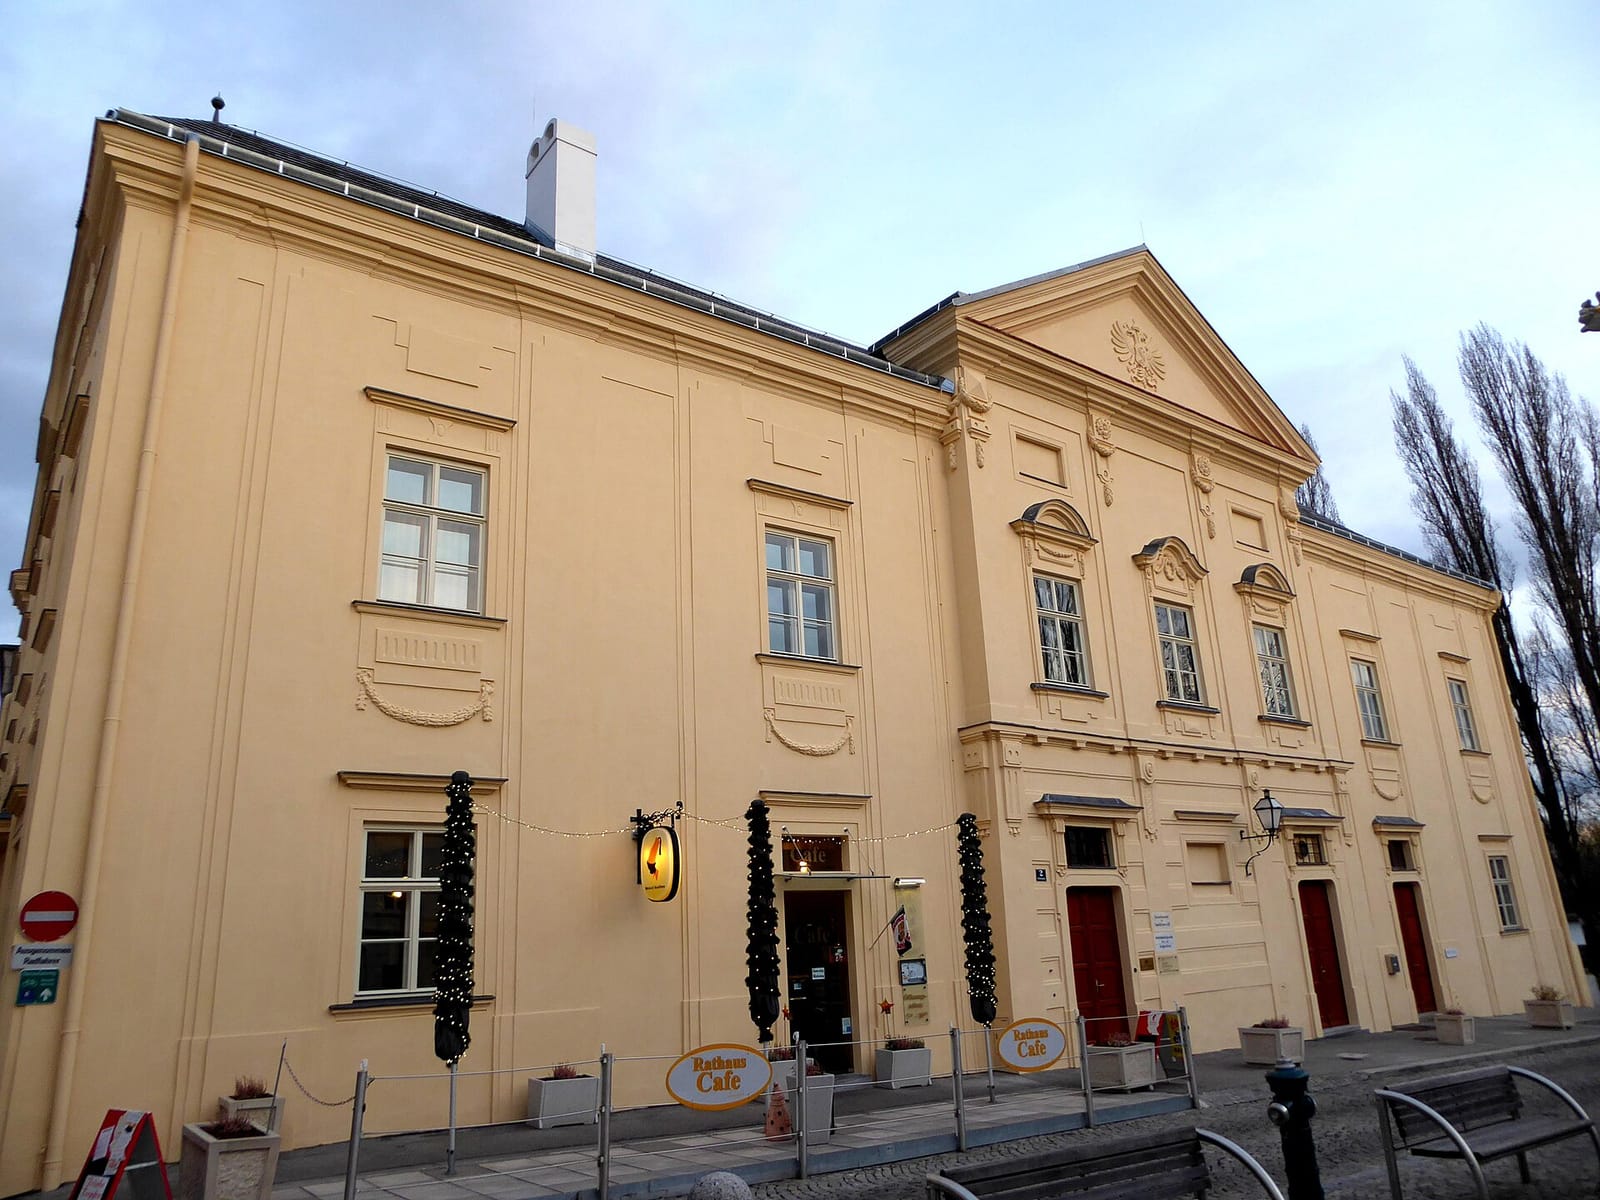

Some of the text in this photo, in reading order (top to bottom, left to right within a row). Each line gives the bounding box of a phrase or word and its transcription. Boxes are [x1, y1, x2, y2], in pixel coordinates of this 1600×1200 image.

[1012, 1028, 1049, 1041] Rathaus
[1017, 1040, 1047, 1058] Cafe
[691, 1056, 747, 1072] Rathaus
[696, 1070, 741, 1093] Cafe
